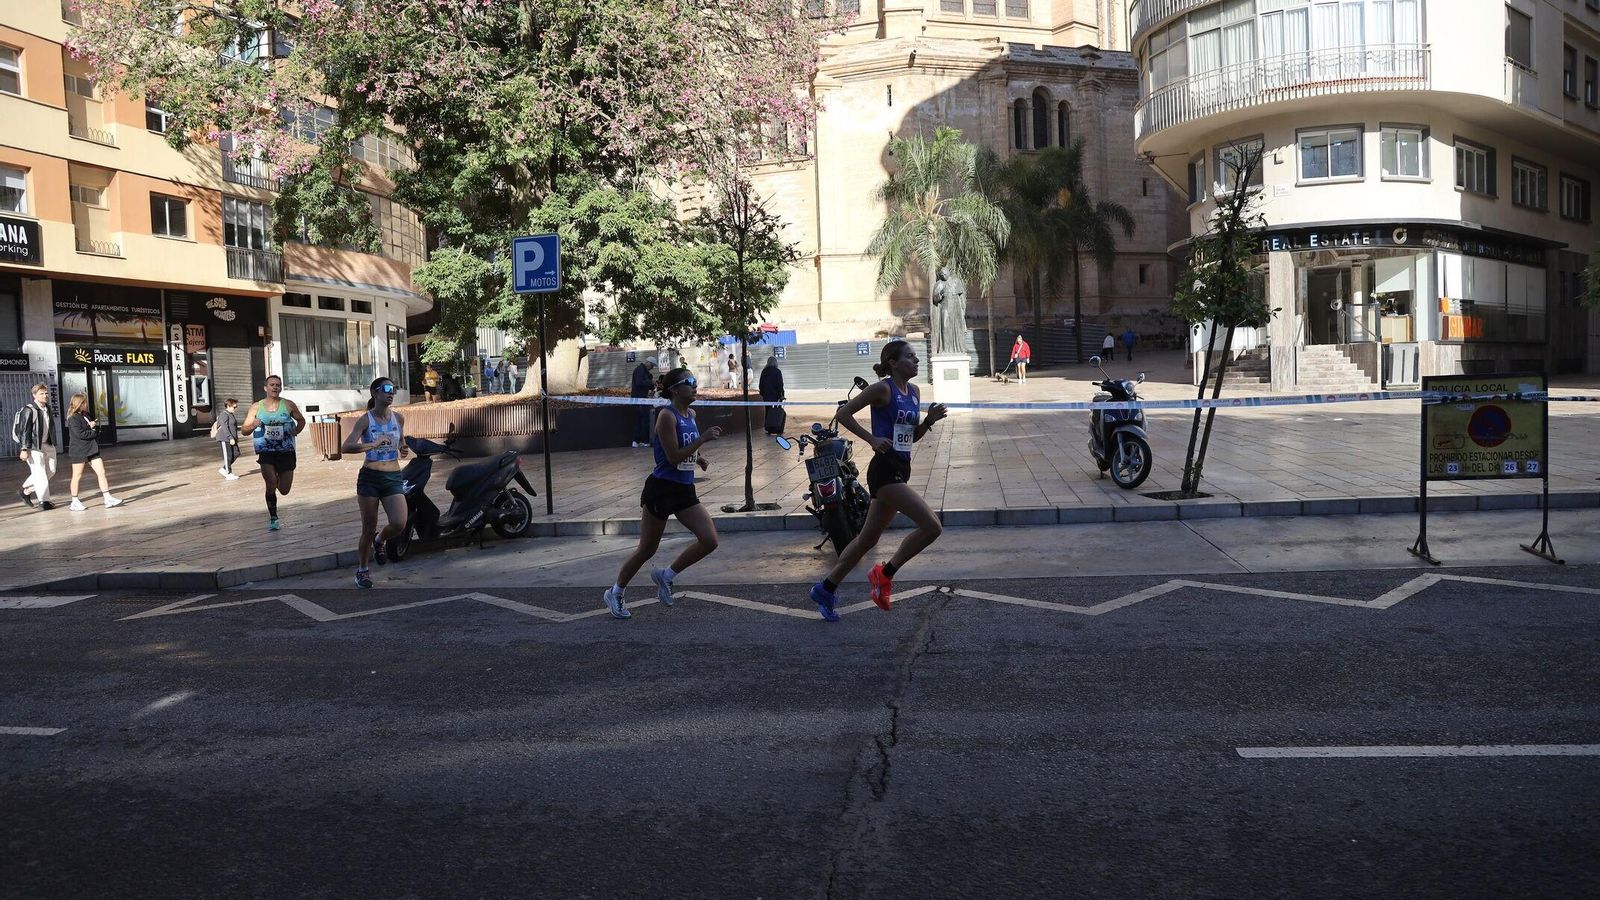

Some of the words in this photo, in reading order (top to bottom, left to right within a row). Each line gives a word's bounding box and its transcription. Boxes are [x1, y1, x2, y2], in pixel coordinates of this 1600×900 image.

[0, 223, 28, 244] ANA
[1262, 236, 1300, 252] REAL
[1310, 232, 1370, 246] ESTATE
[516, 242, 544, 286] P
[530, 277, 556, 287] MOTOS
[186, 328, 204, 336] ATM
[94, 354, 123, 362] PARQUE
[126, 353, 154, 364] FLATS
[174, 334, 184, 412] SNEAKERS
[1476, 384, 1508, 392] LOCAL
[1430, 452, 1468, 462] PROHIBIDO
[1469, 451, 1513, 461] ESTACIONAR
[1430, 464, 1442, 473] LAS
[1472, 463, 1486, 472] DEL
